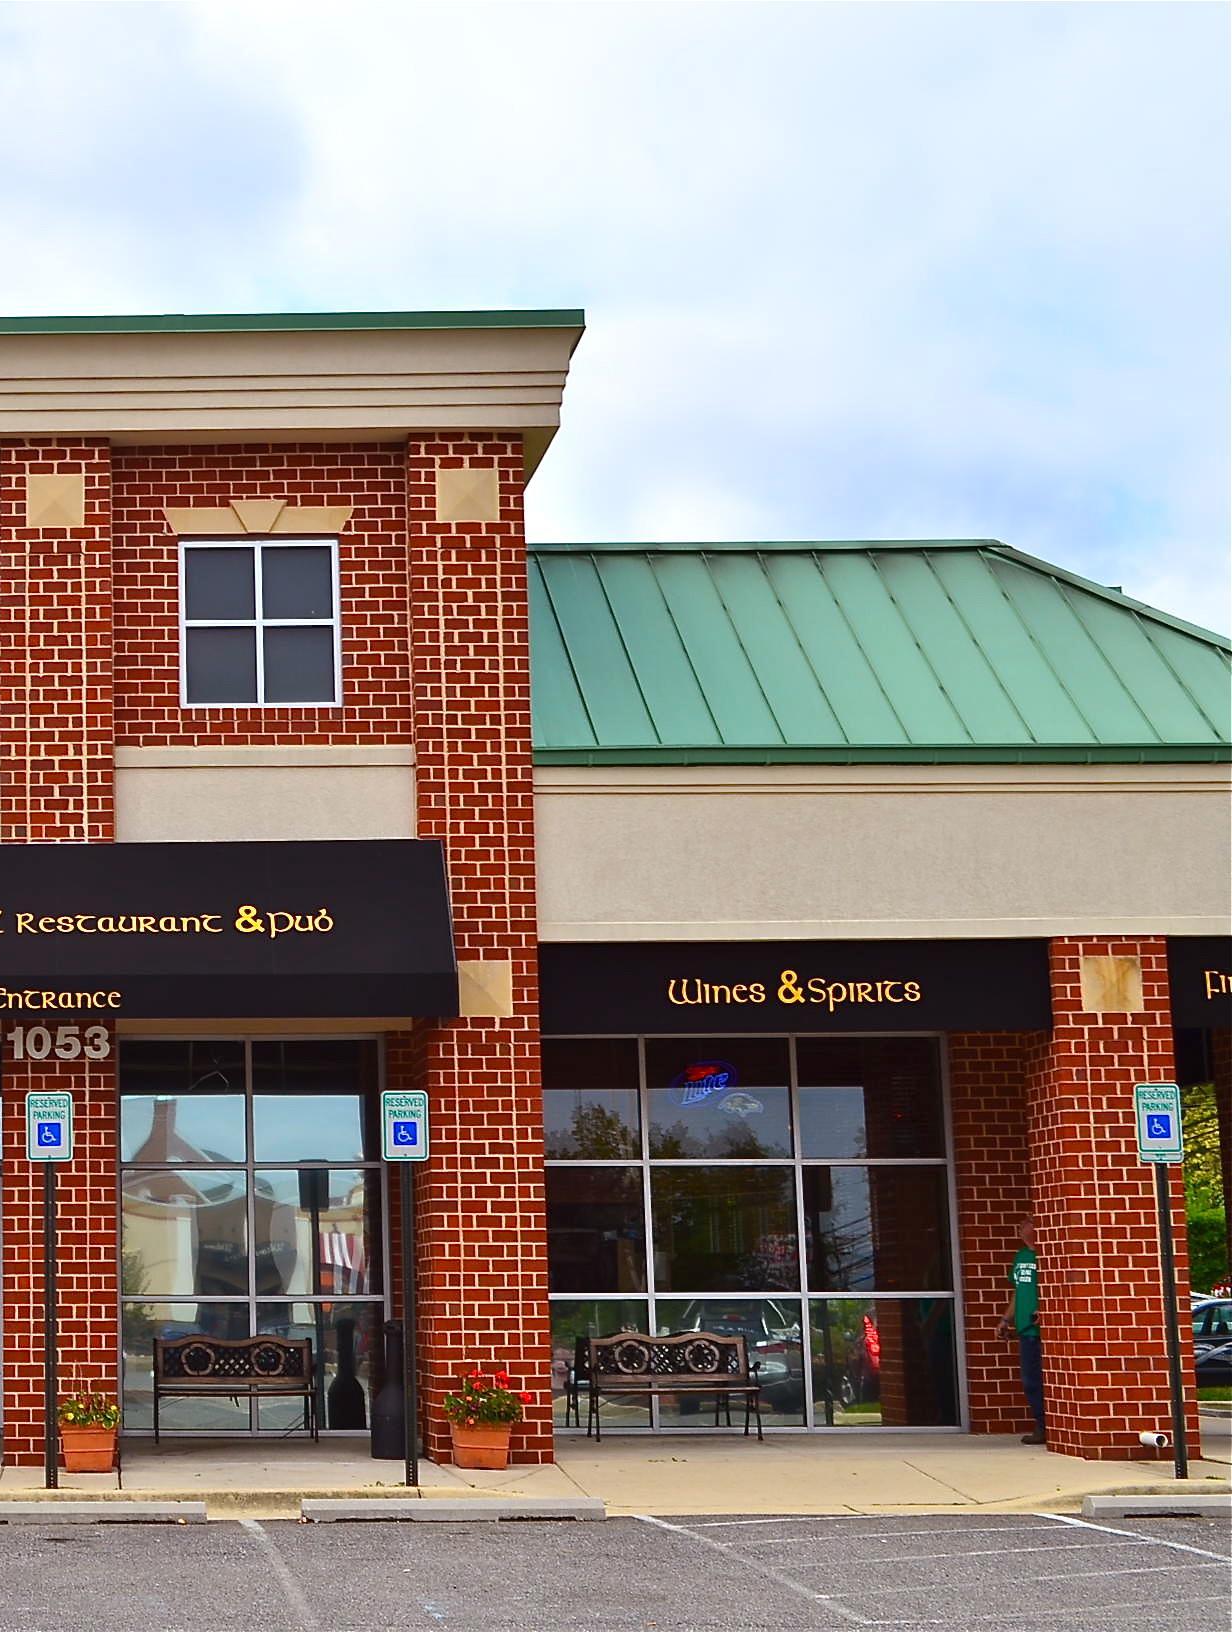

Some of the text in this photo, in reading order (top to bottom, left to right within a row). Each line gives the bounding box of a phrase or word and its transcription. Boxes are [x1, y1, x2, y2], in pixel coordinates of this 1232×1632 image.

[15, 912, 224, 934] Restaurant
[668, 978, 766, 1005] Wines
[7, 1026, 111, 1060] 1053
[1136, 1090, 1176, 1100] RESERVED
[30, 1099, 69, 1109] RESERVED
[384, 1097, 424, 1107] RESERVED
[1141, 1102, 1174, 1112] PARKING
[33, 1110, 66, 1120] PARKING
[388, 1109, 422, 1119] PARKING
